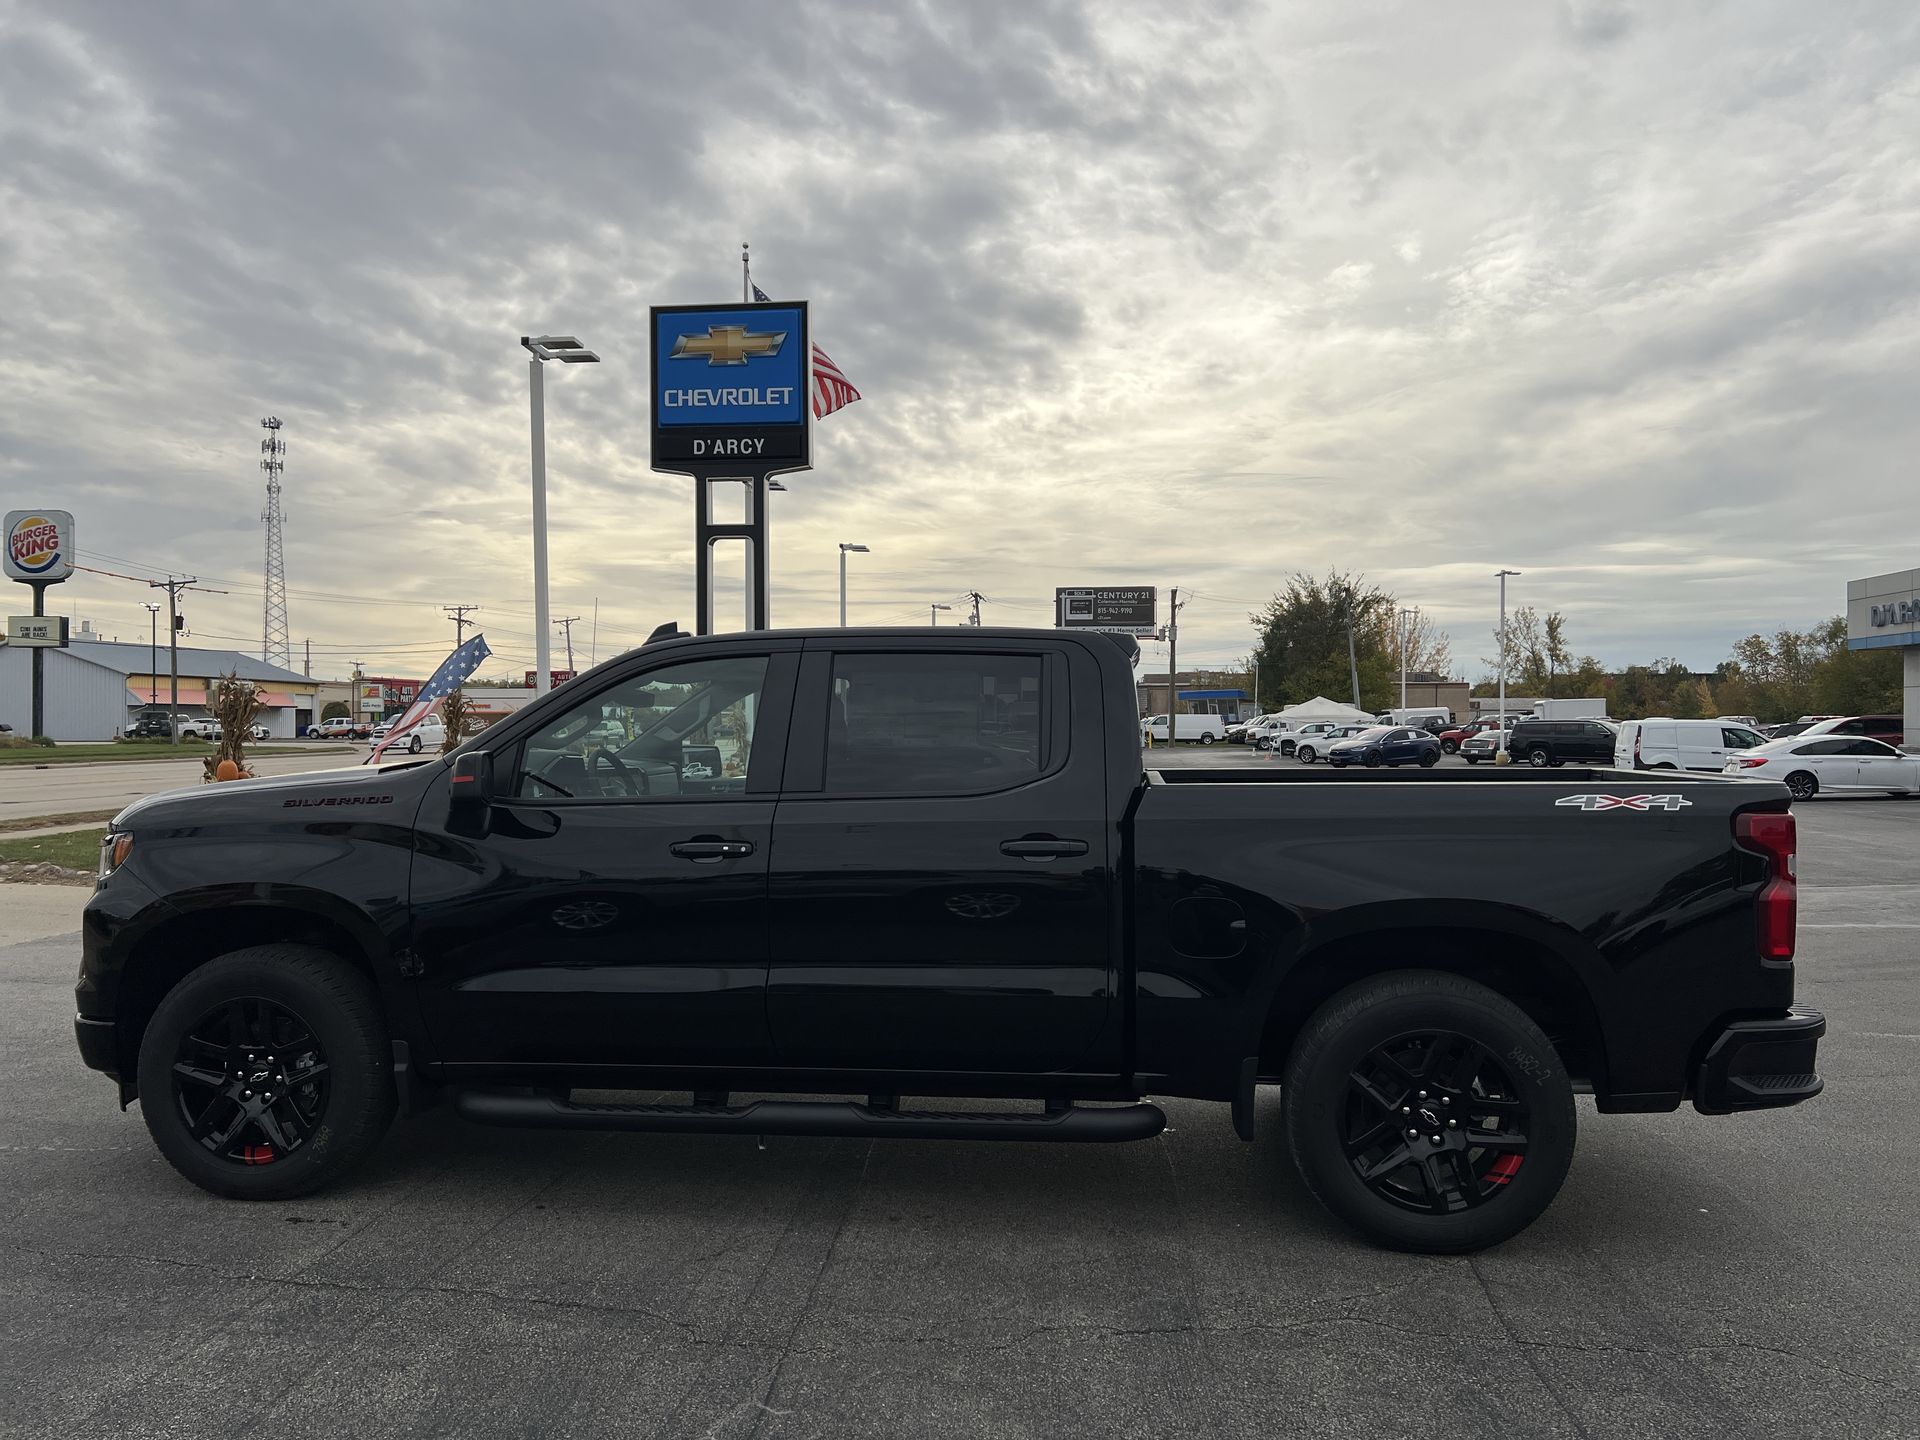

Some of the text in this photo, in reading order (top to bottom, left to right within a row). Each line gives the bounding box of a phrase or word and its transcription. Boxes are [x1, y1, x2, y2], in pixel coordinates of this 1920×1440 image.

[664, 387, 793, 407] CHEVROLET
[693, 438, 765, 455] D'ARCY
[12, 524, 57, 547] BURGER
[14, 535, 59, 561] KING
[1097, 591, 1149, 599] CENTURY 21
[283, 795, 394, 808] SILVERADO
[1555, 794, 1693, 811] 4X4
